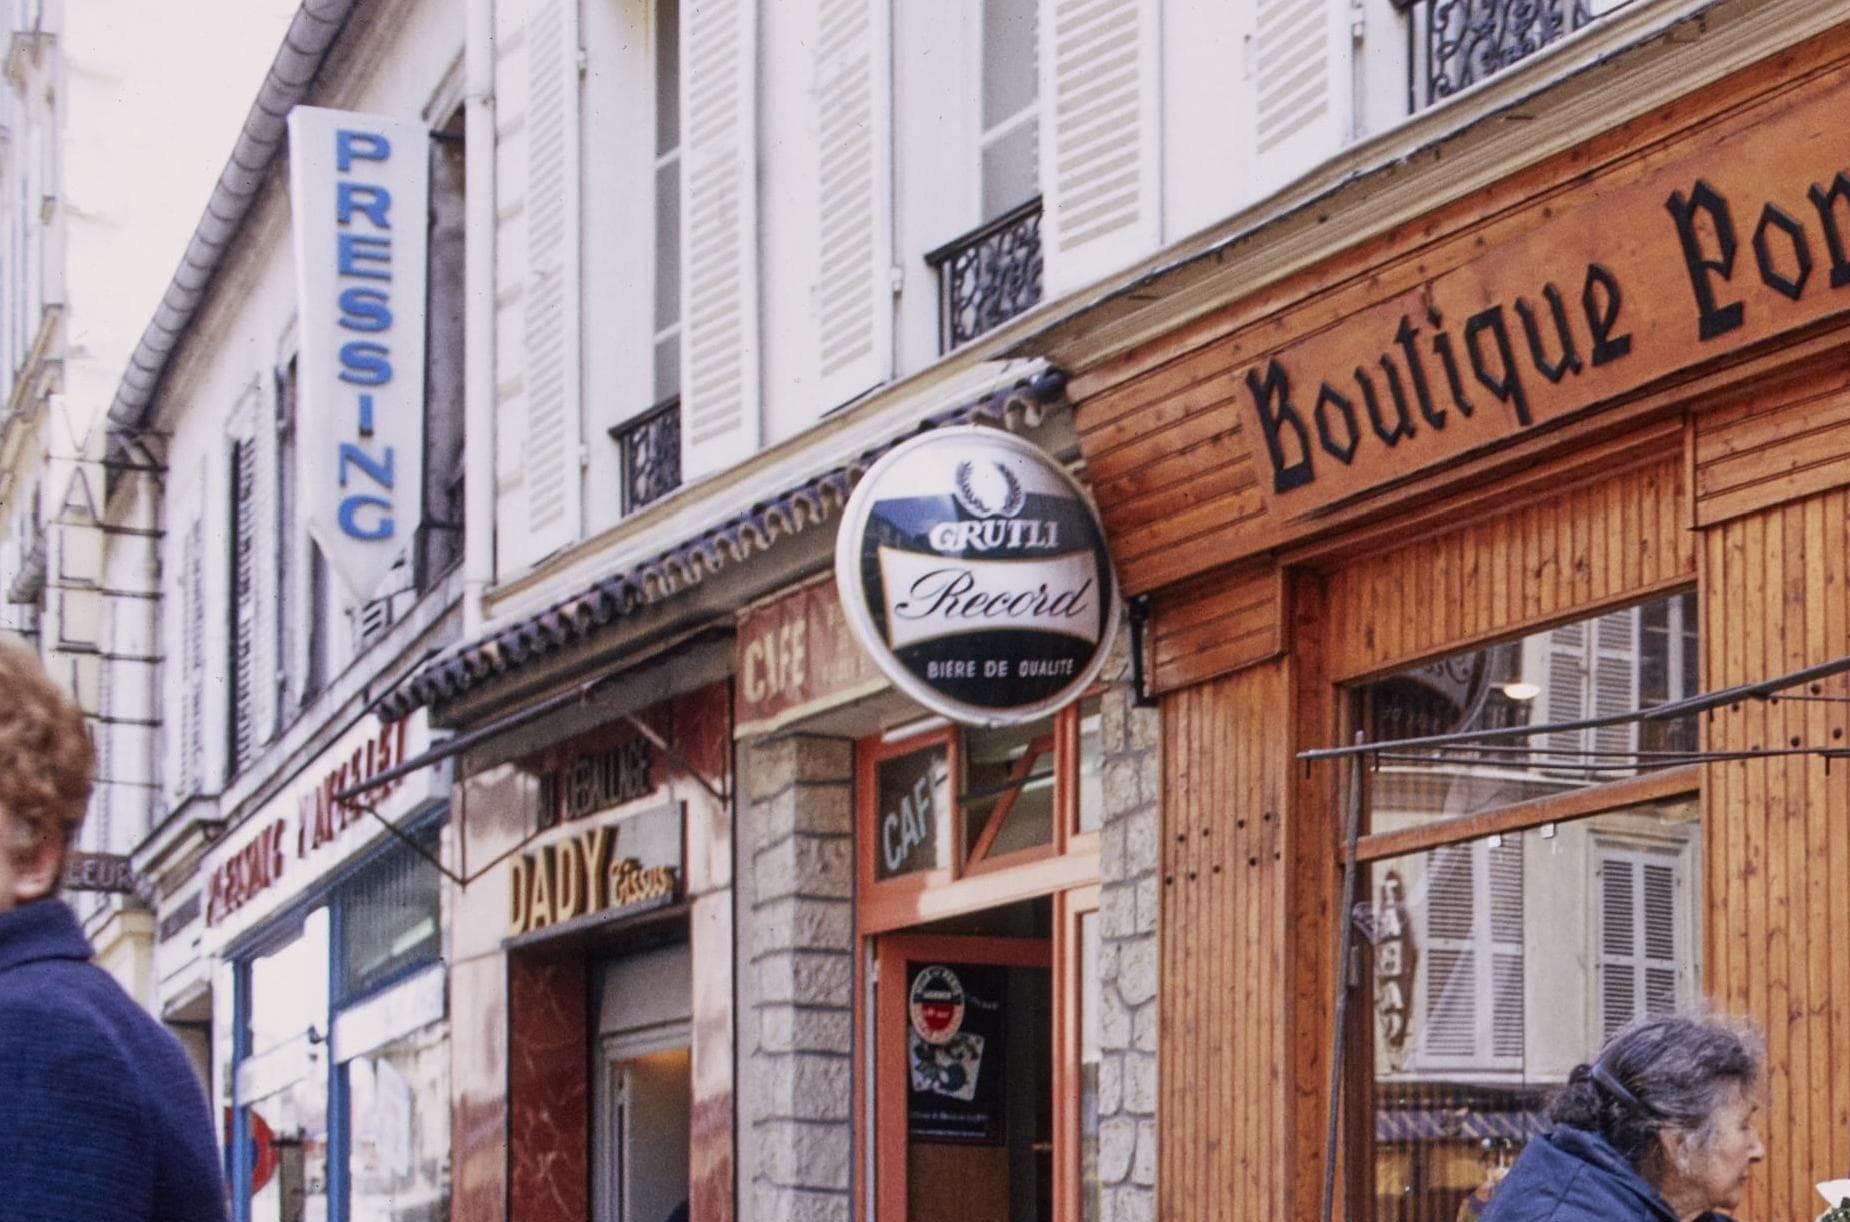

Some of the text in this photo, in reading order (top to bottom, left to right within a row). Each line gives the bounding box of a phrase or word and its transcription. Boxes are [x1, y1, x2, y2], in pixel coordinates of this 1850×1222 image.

[335, 128, 394, 542] PRESSING
[1245, 262, 1632, 494] Boutique
[894, 567, 1093, 620] Record
[983, 659, 1009, 678] DE
[508, 826, 617, 937] DADY
